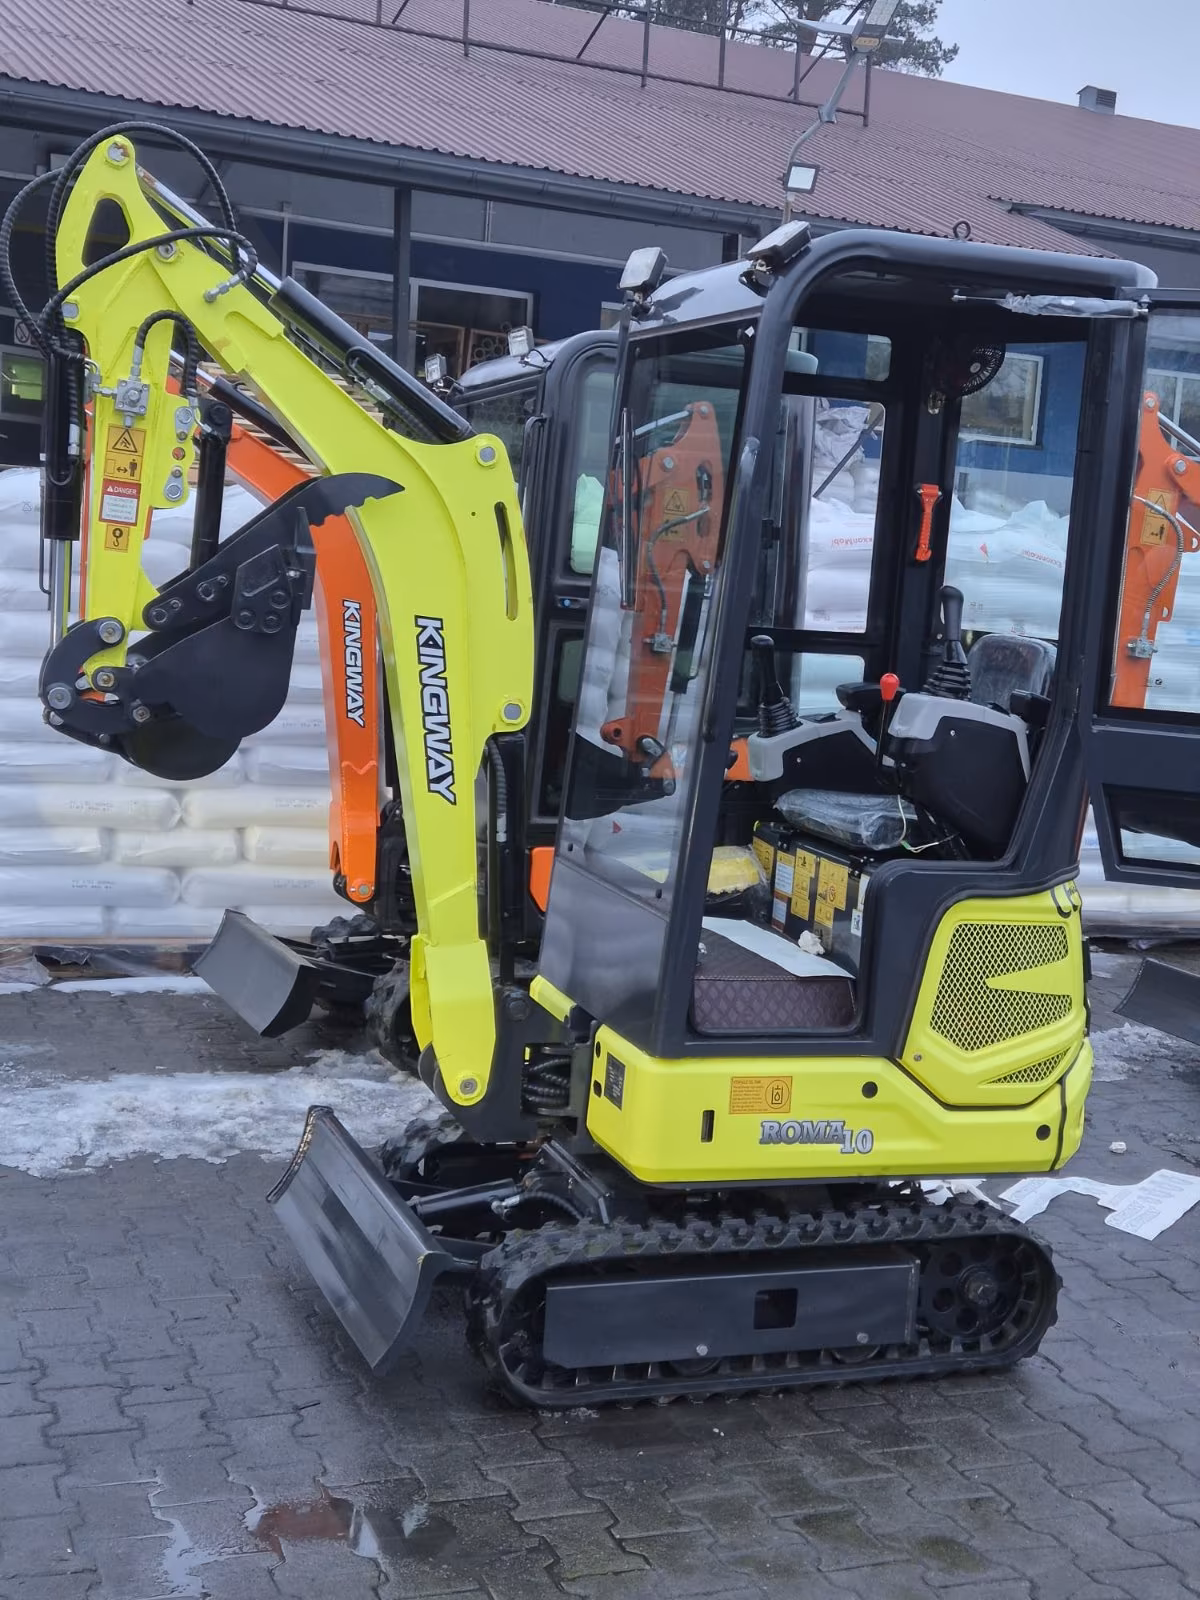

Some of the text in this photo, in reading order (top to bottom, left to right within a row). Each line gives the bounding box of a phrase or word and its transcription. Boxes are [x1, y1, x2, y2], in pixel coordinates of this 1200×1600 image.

[114, 486, 136, 494] DANGER
[343, 599, 366, 728] KINGWAY
[414, 615, 457, 805] KINGWAY
